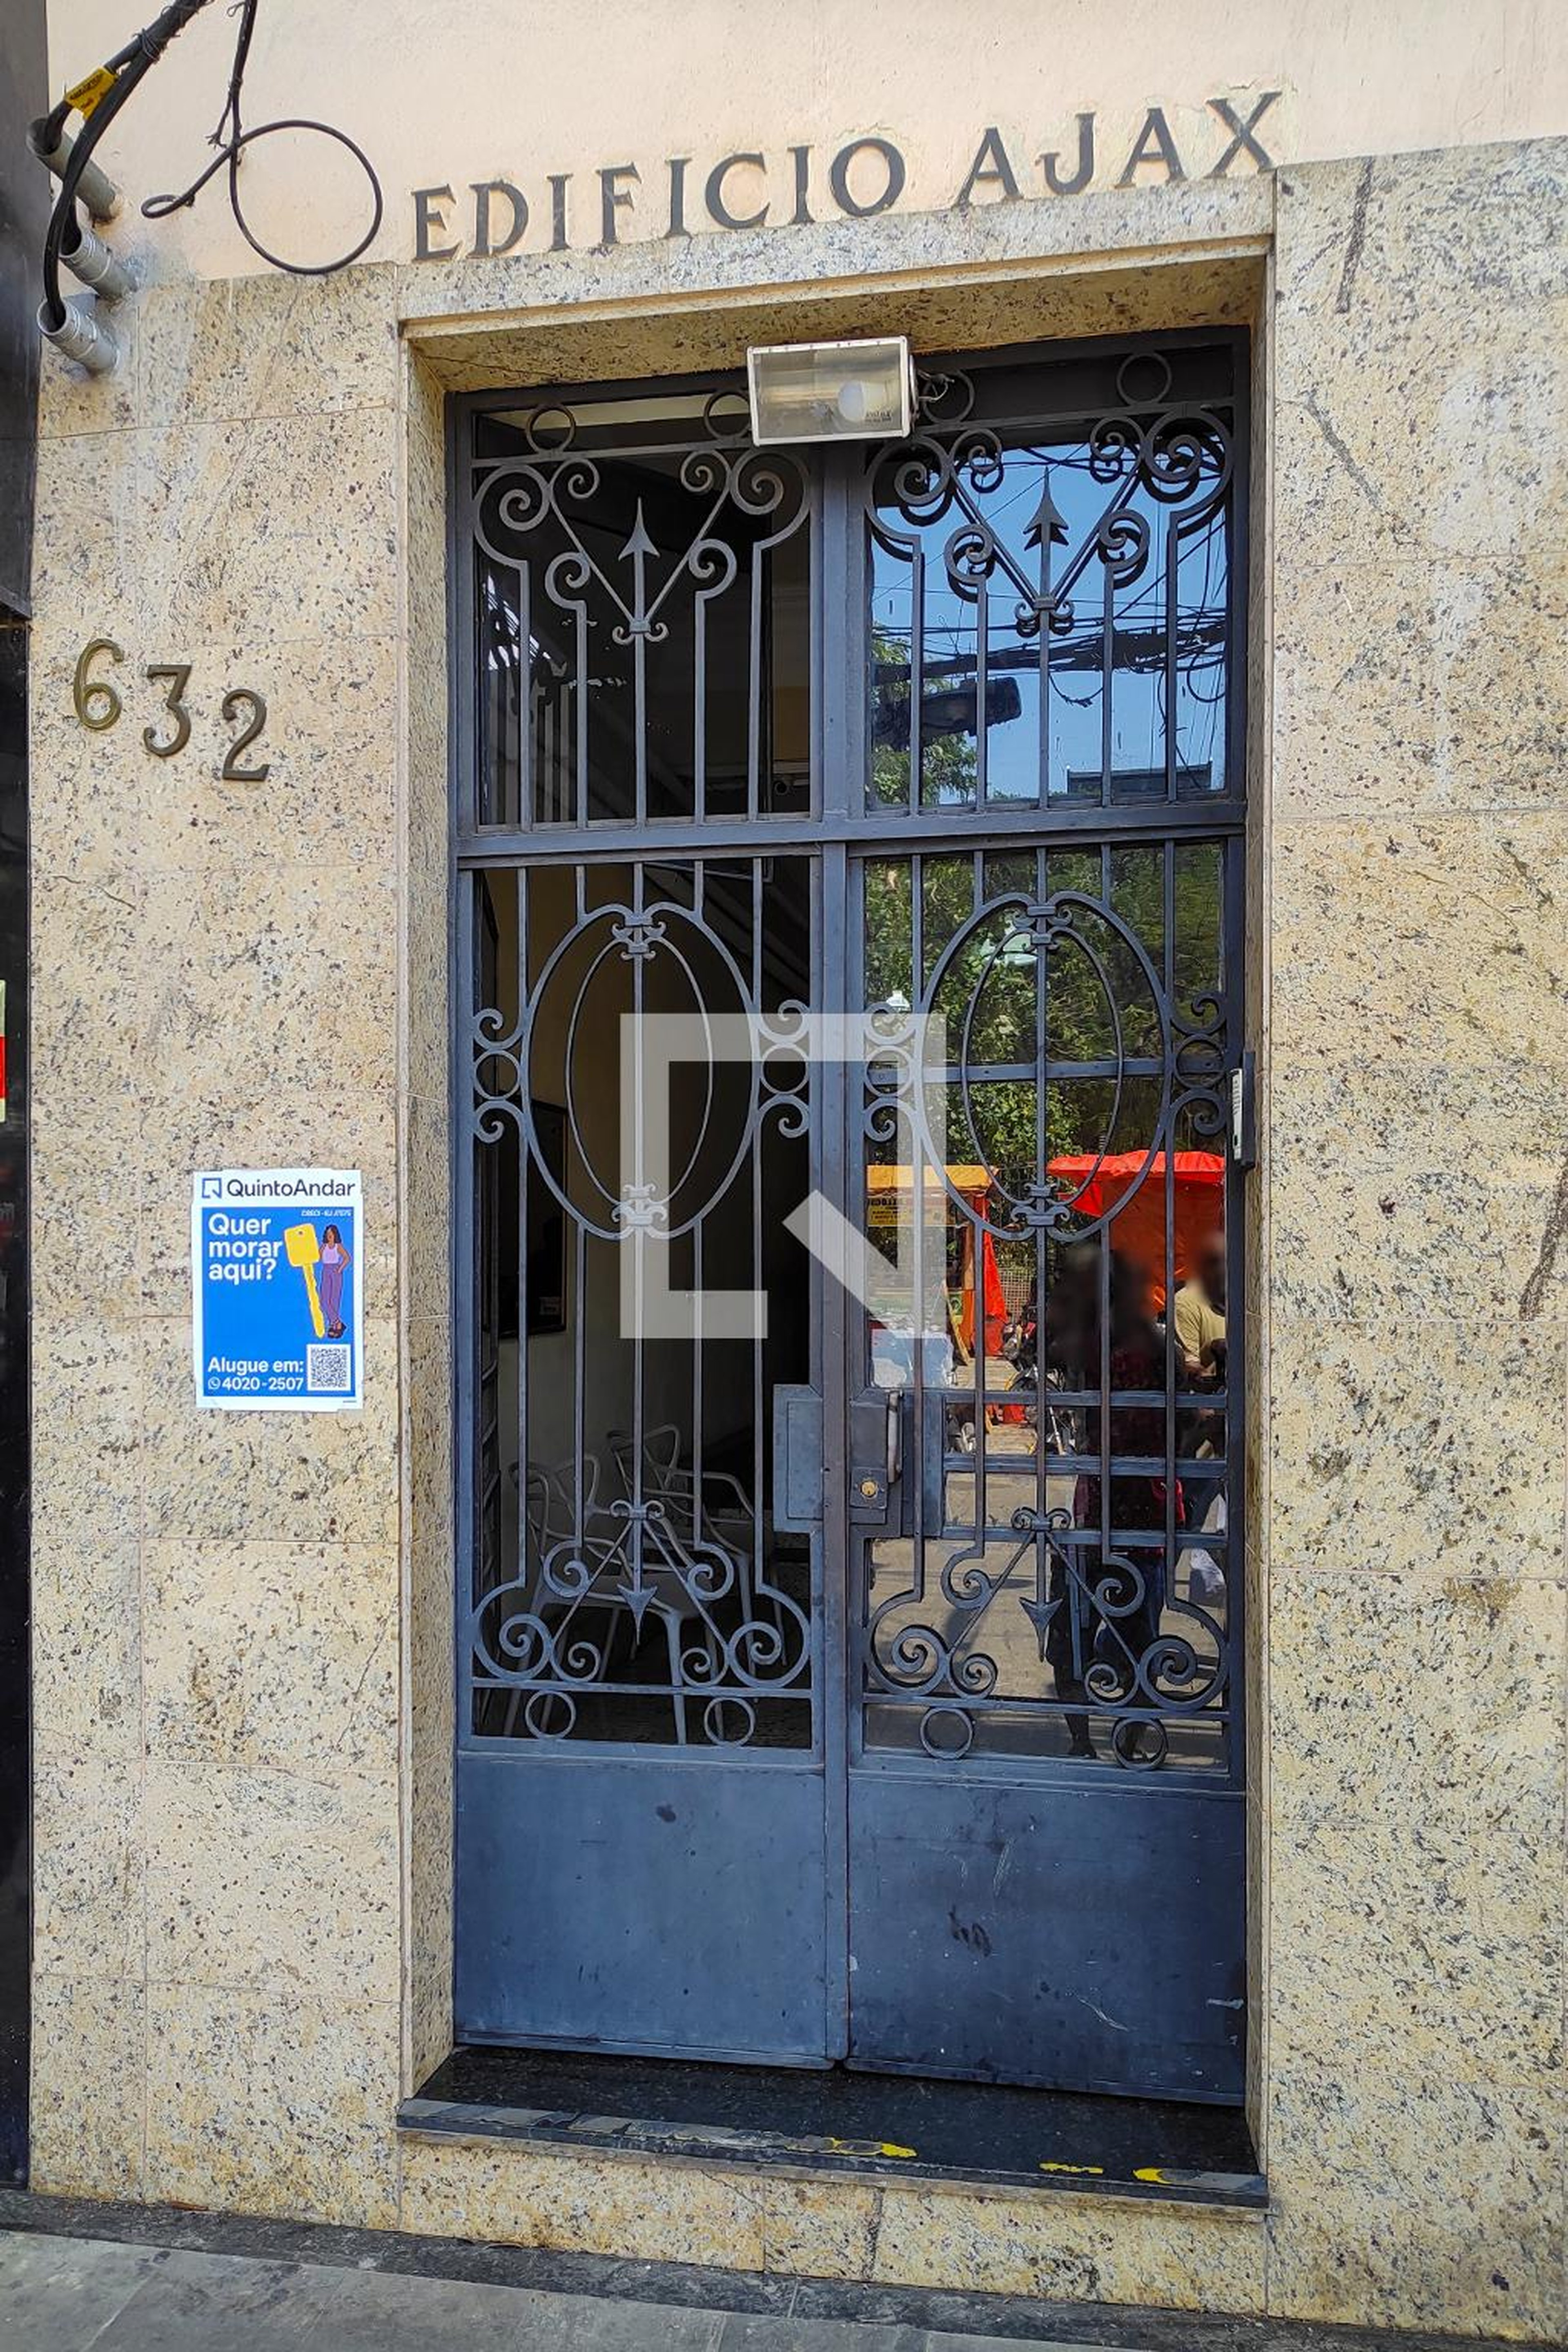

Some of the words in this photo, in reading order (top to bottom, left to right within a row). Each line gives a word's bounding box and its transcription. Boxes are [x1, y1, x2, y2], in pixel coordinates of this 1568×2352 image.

[411, 138, 906, 261] EDIFICIO
[952, 91, 1282, 210] AJAX
[74, 638, 270, 781] 632
[227, 1178, 355, 1197] QuintoAndar
[208, 1213, 271, 1236] Quer
[209, 1240, 283, 1258] morar
[209, 1258, 276, 1285] aqui?
[207, 1356, 269, 1376] Alugue
[272, 1360, 304, 1373] em:
